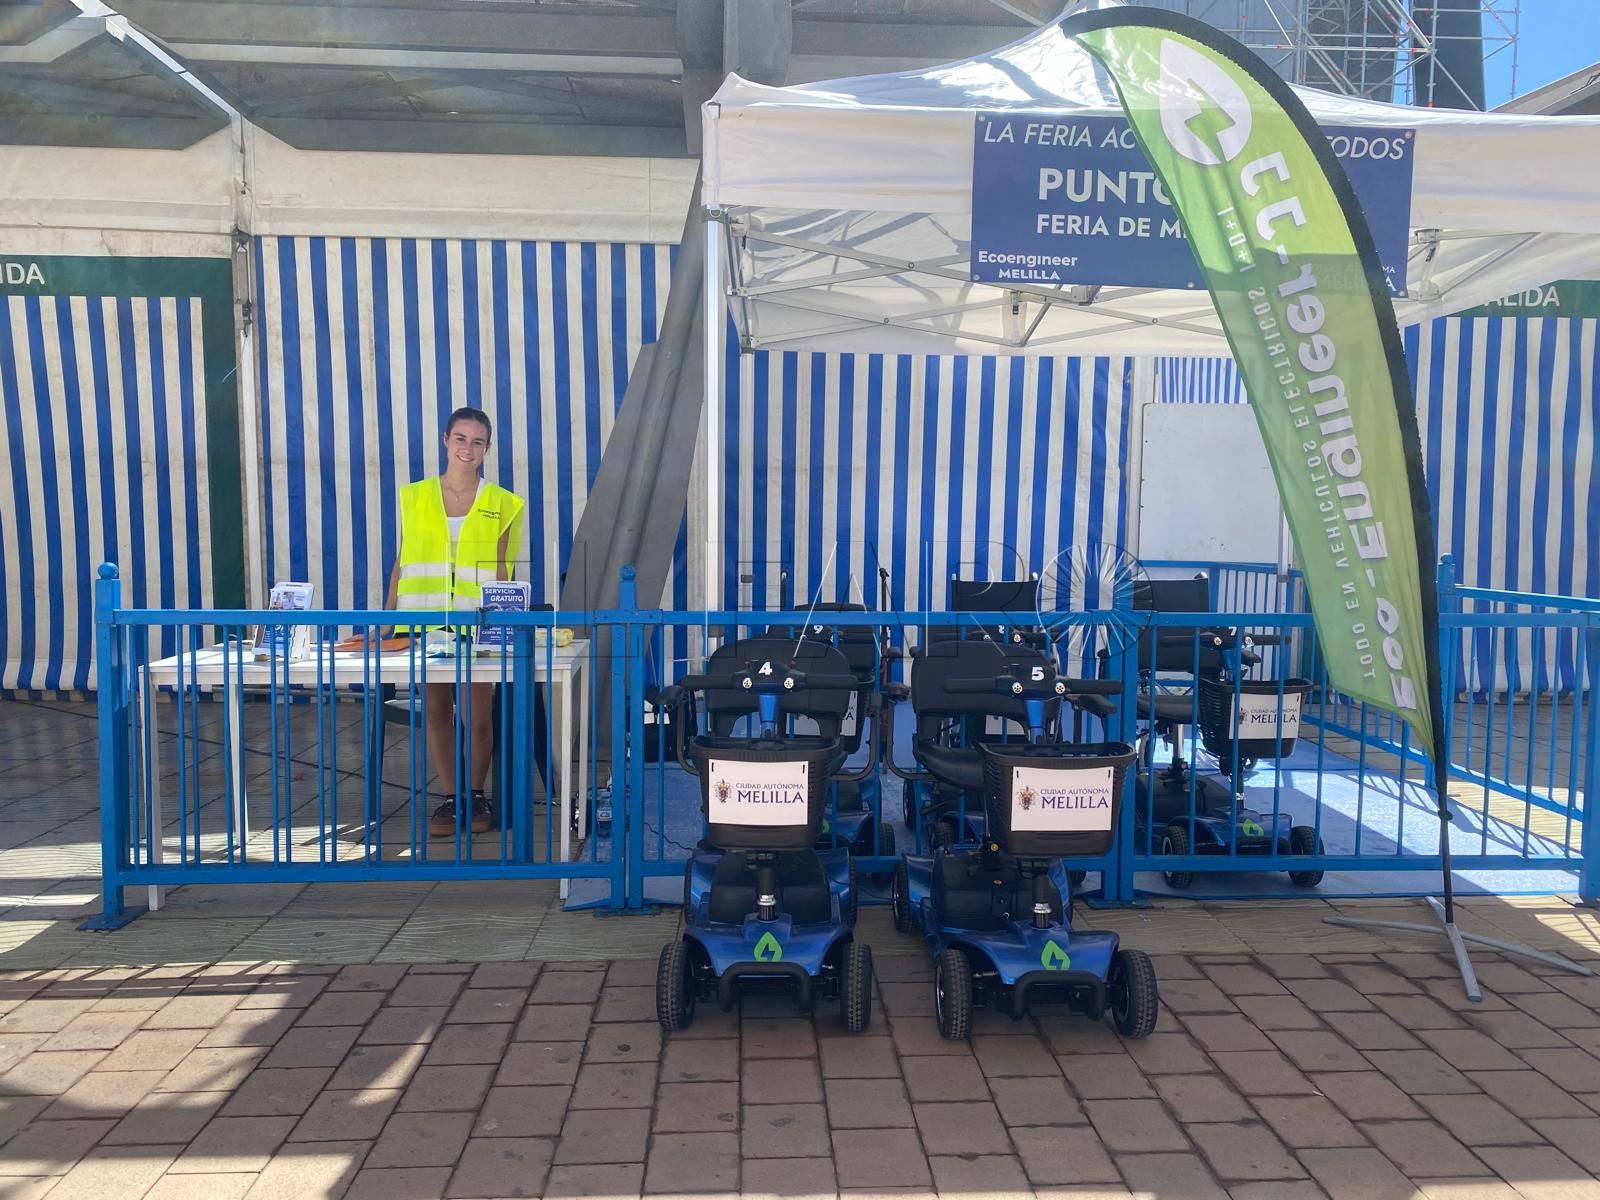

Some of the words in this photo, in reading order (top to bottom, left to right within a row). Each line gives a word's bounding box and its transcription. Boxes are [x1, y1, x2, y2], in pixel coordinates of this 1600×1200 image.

[984, 121, 1015, 143] LA
[1024, 123, 1092, 148] FERIA
[1099, 126, 1136, 149] AC
[1325, 135, 1406, 160] ODOS
[1036, 213, 1110, 237] FERIA
[1118, 217, 1151, 238] DE
[978, 250, 1079, 268] Ecoengineer
[0, 262, 46, 285] IDA
[998, 268, 1062, 281] MELILLA
[813, 624, 824, 634] 9
[1228, 626, 1237, 636] 7
[758, 661, 773, 676] 4
[1031, 666, 1045, 681] 5
[1251, 714, 1297, 724] MELILA
[763, 782, 804, 790] AUTÓNOMA
[1068, 787, 1110, 795] AUTÓNOMA
[737, 790, 805, 804] MELILLA
[1041, 796, 1110, 809] MELILLA
